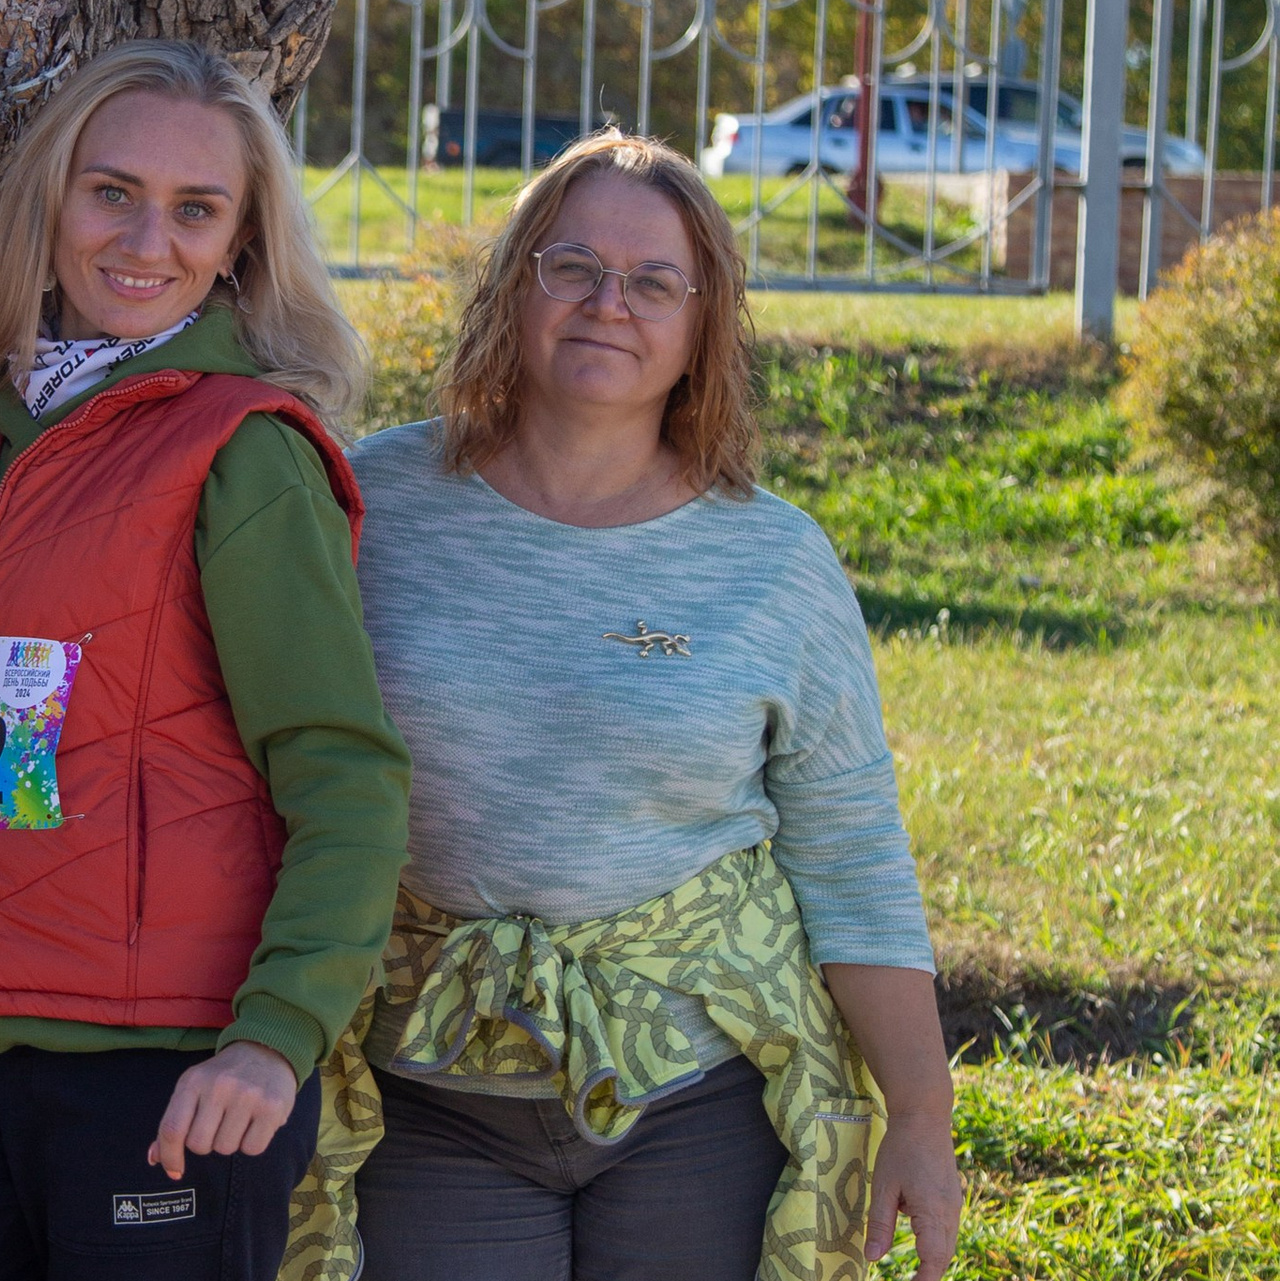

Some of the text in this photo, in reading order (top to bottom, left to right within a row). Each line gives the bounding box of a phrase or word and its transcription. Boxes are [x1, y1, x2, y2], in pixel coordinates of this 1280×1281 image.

[4, 669, 51, 678] ВСЕРОССИЙСКИЙ
[2, 677, 49, 687] ДЕНЬ ХОДЬБЫ
[15, 688, 31, 698] 2024
[117, 1211, 139, 1220] Kappa
[146, 1206, 170, 1216] SINCE
